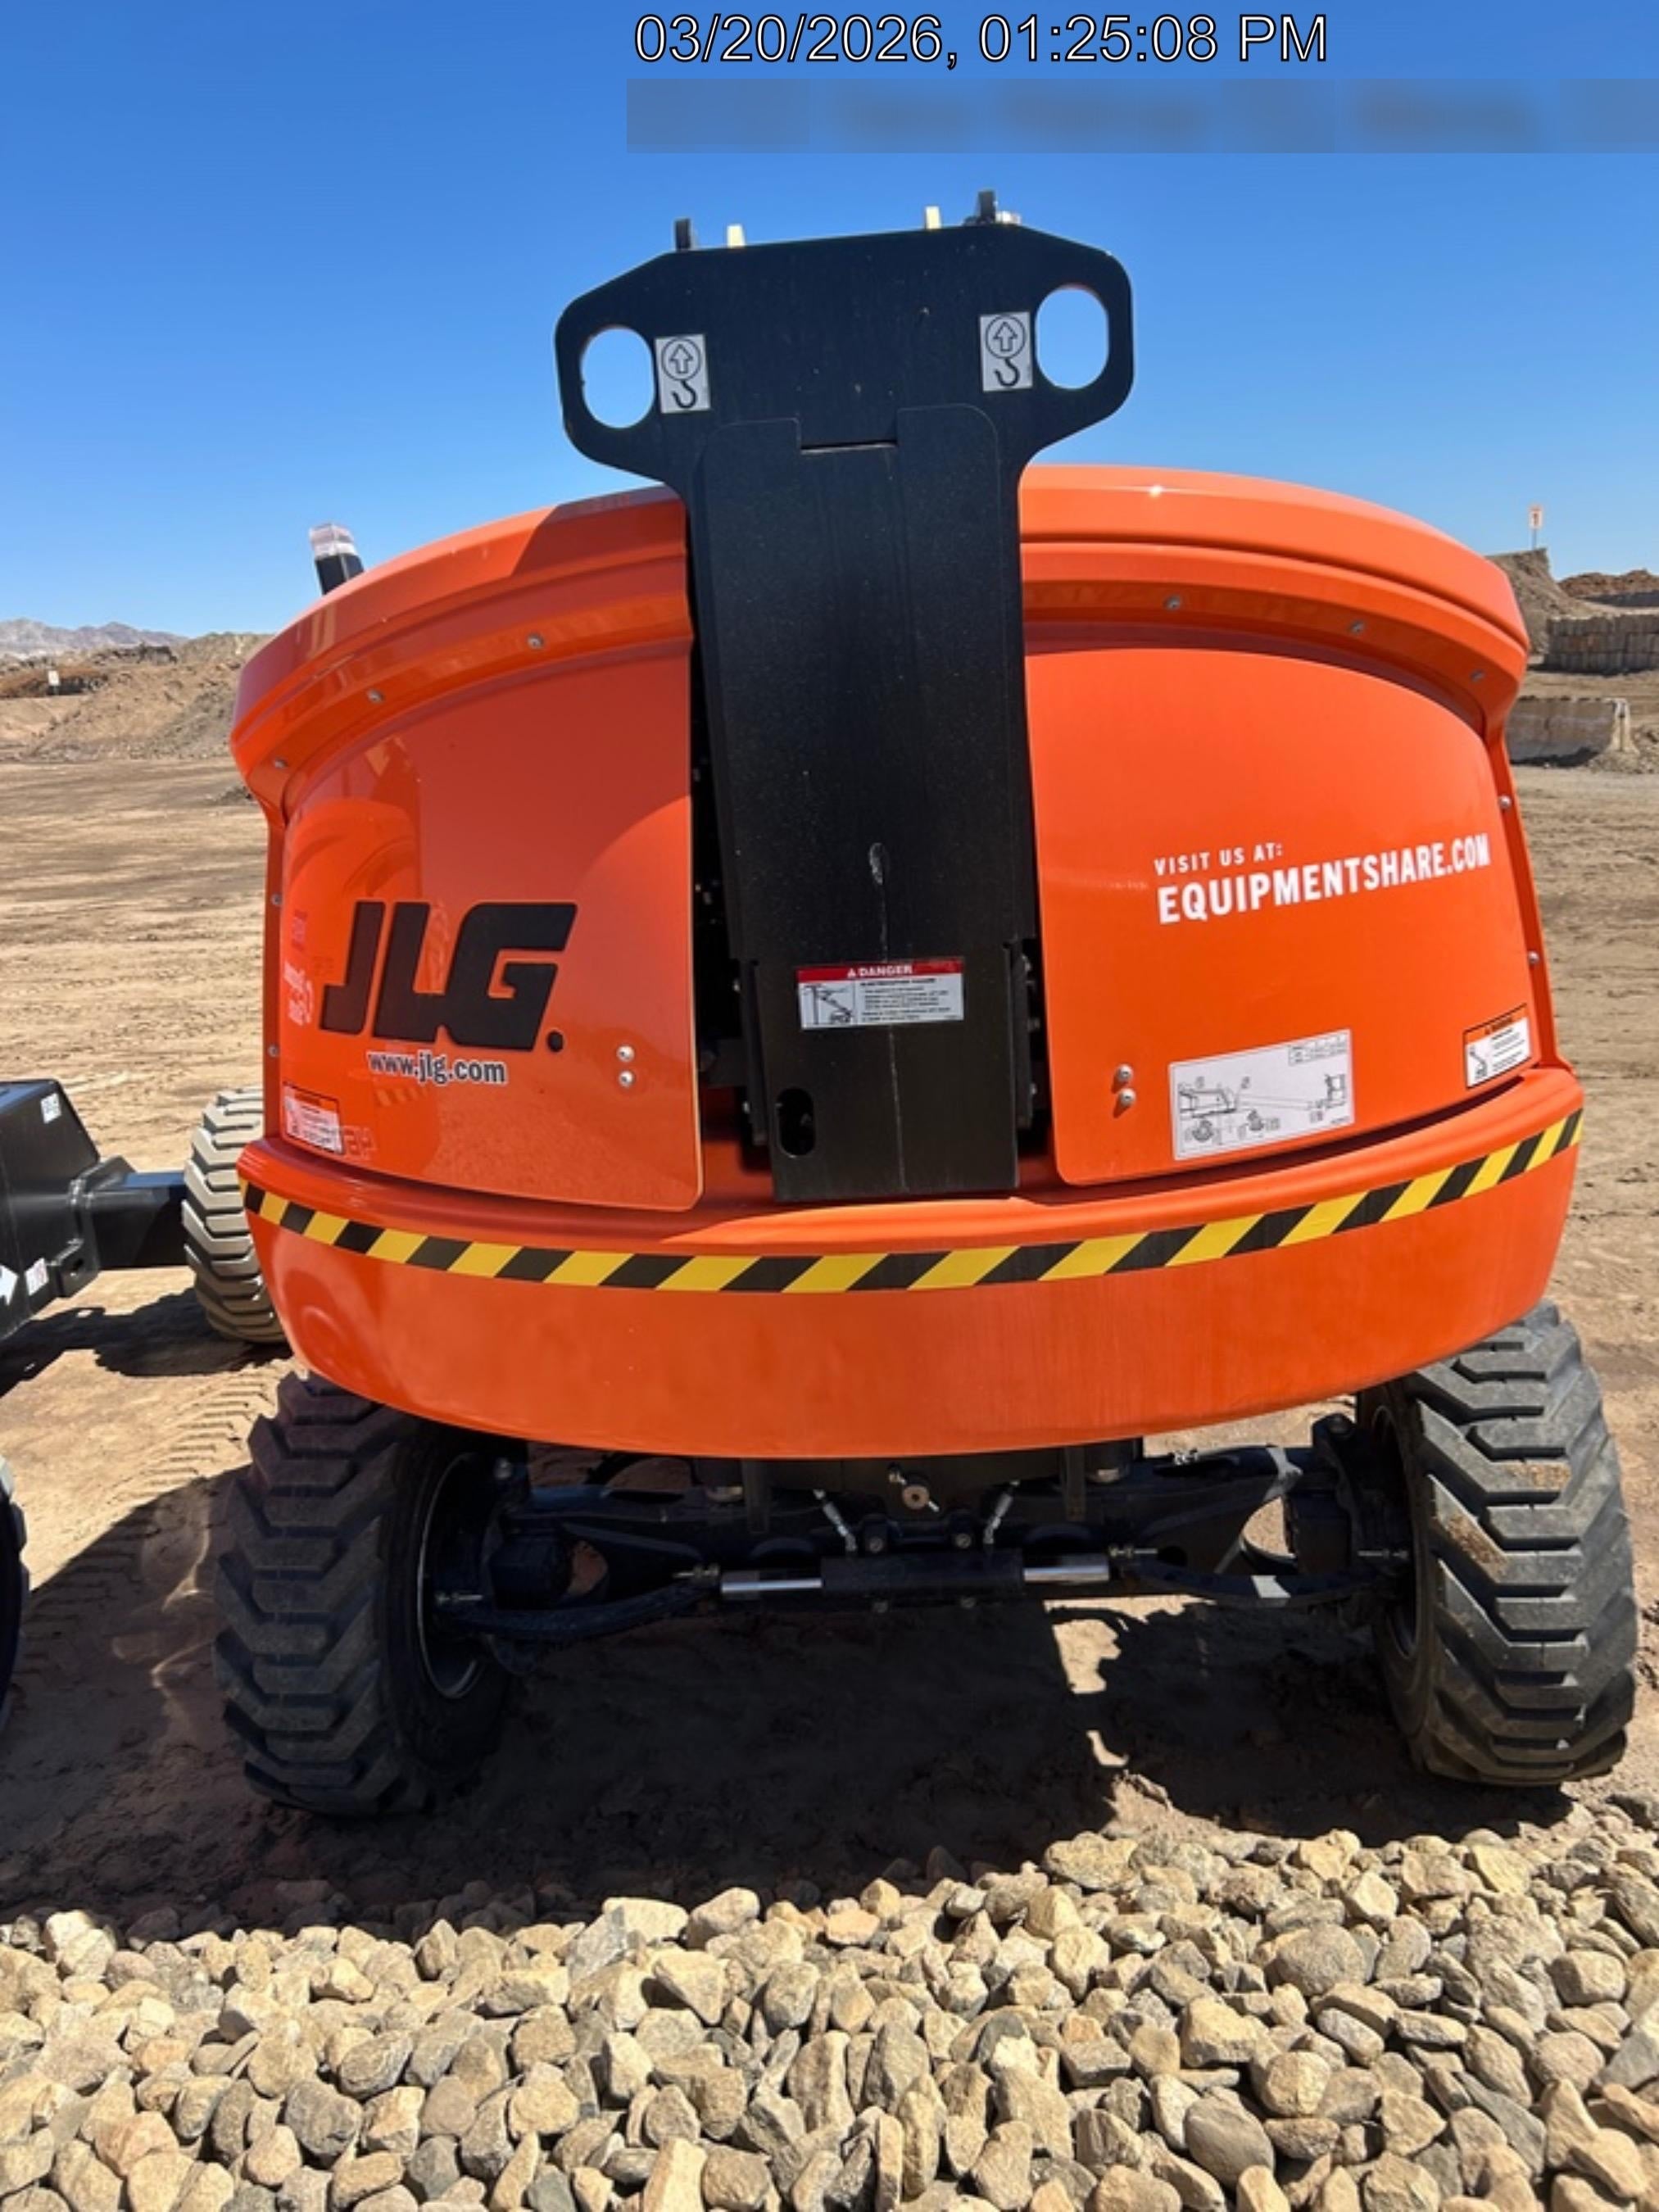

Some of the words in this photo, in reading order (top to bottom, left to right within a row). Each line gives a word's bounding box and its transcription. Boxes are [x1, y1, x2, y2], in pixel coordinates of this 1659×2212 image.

[1154, 853, 1210, 876] VISIT
[1219, 847, 1244, 867] US
[1253, 842, 1284, 861] AT:
[1157, 832, 1491, 924] EQUIPMENTSHARE.COM
[859, 965, 913, 978] DANGER
[367, 1051, 506, 1085] www.jlg.com
